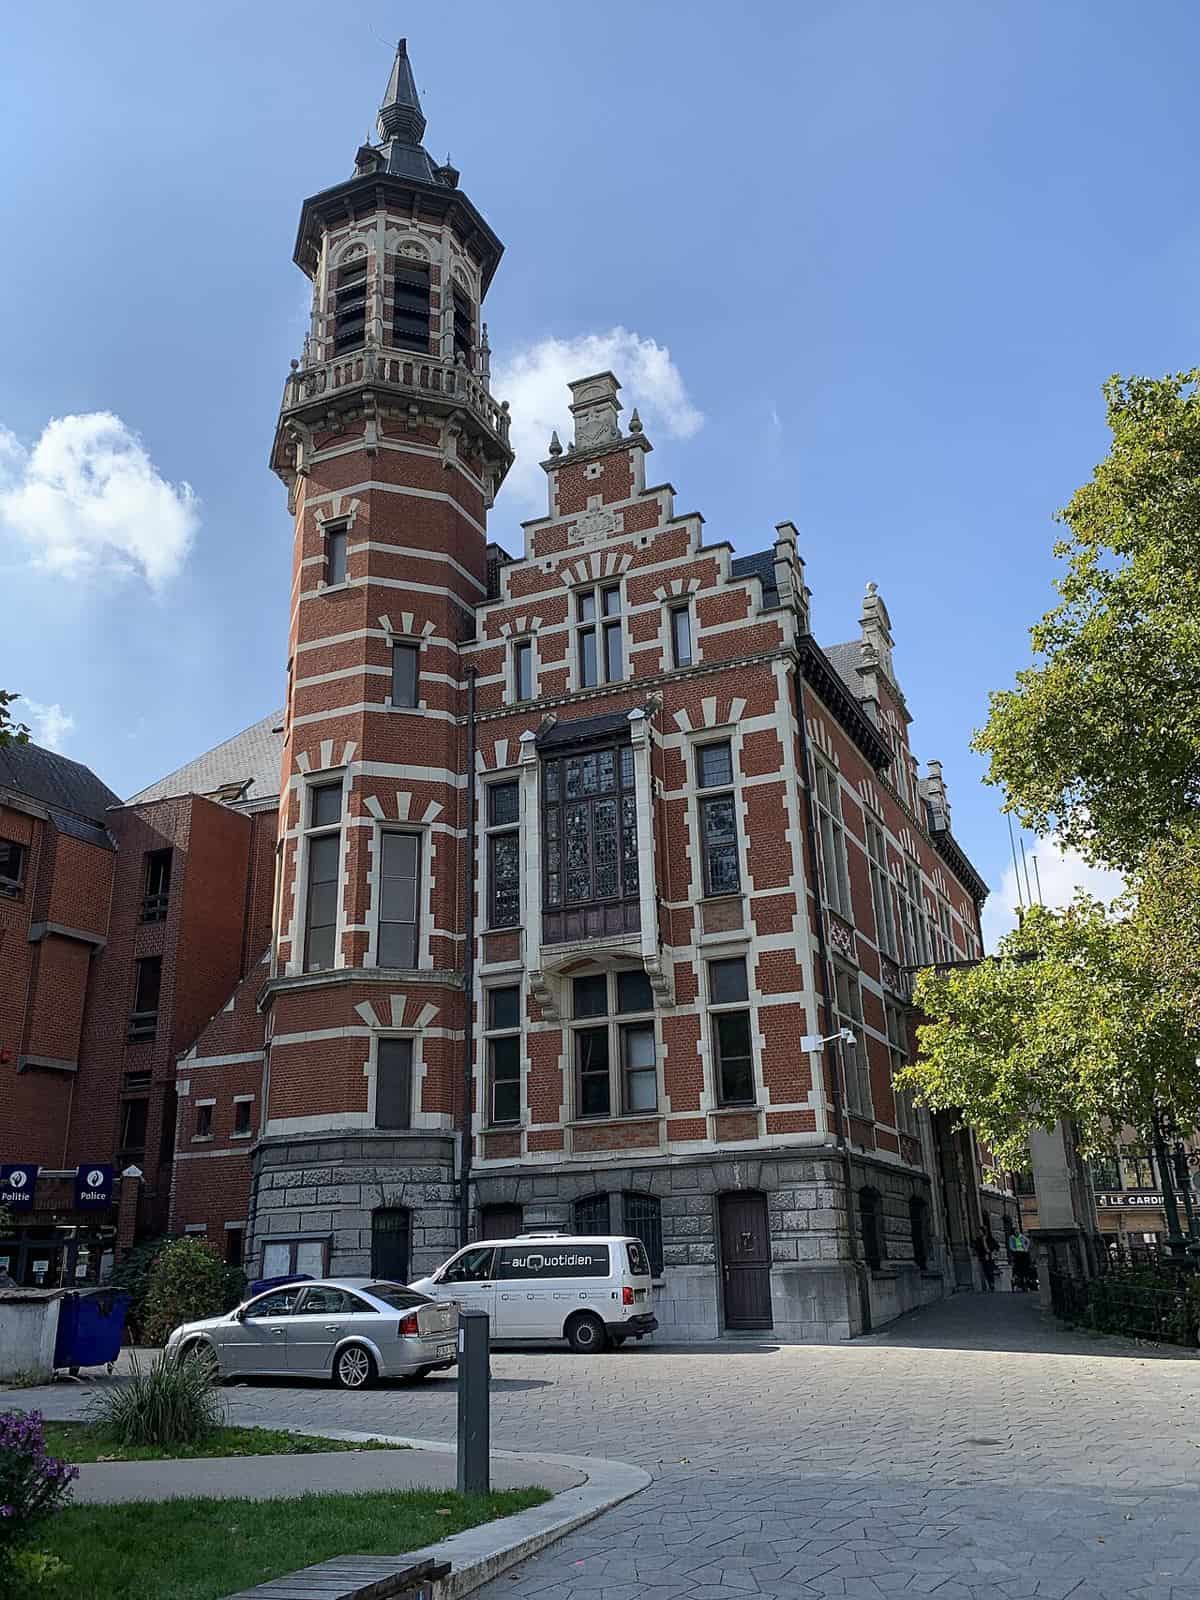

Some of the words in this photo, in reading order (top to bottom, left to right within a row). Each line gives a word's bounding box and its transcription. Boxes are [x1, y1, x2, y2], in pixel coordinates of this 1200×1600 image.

[2, 1191, 30, 1201] Politie
[80, 1191, 106, 1200] Police
[1111, 1196, 1124, 1205] LE
